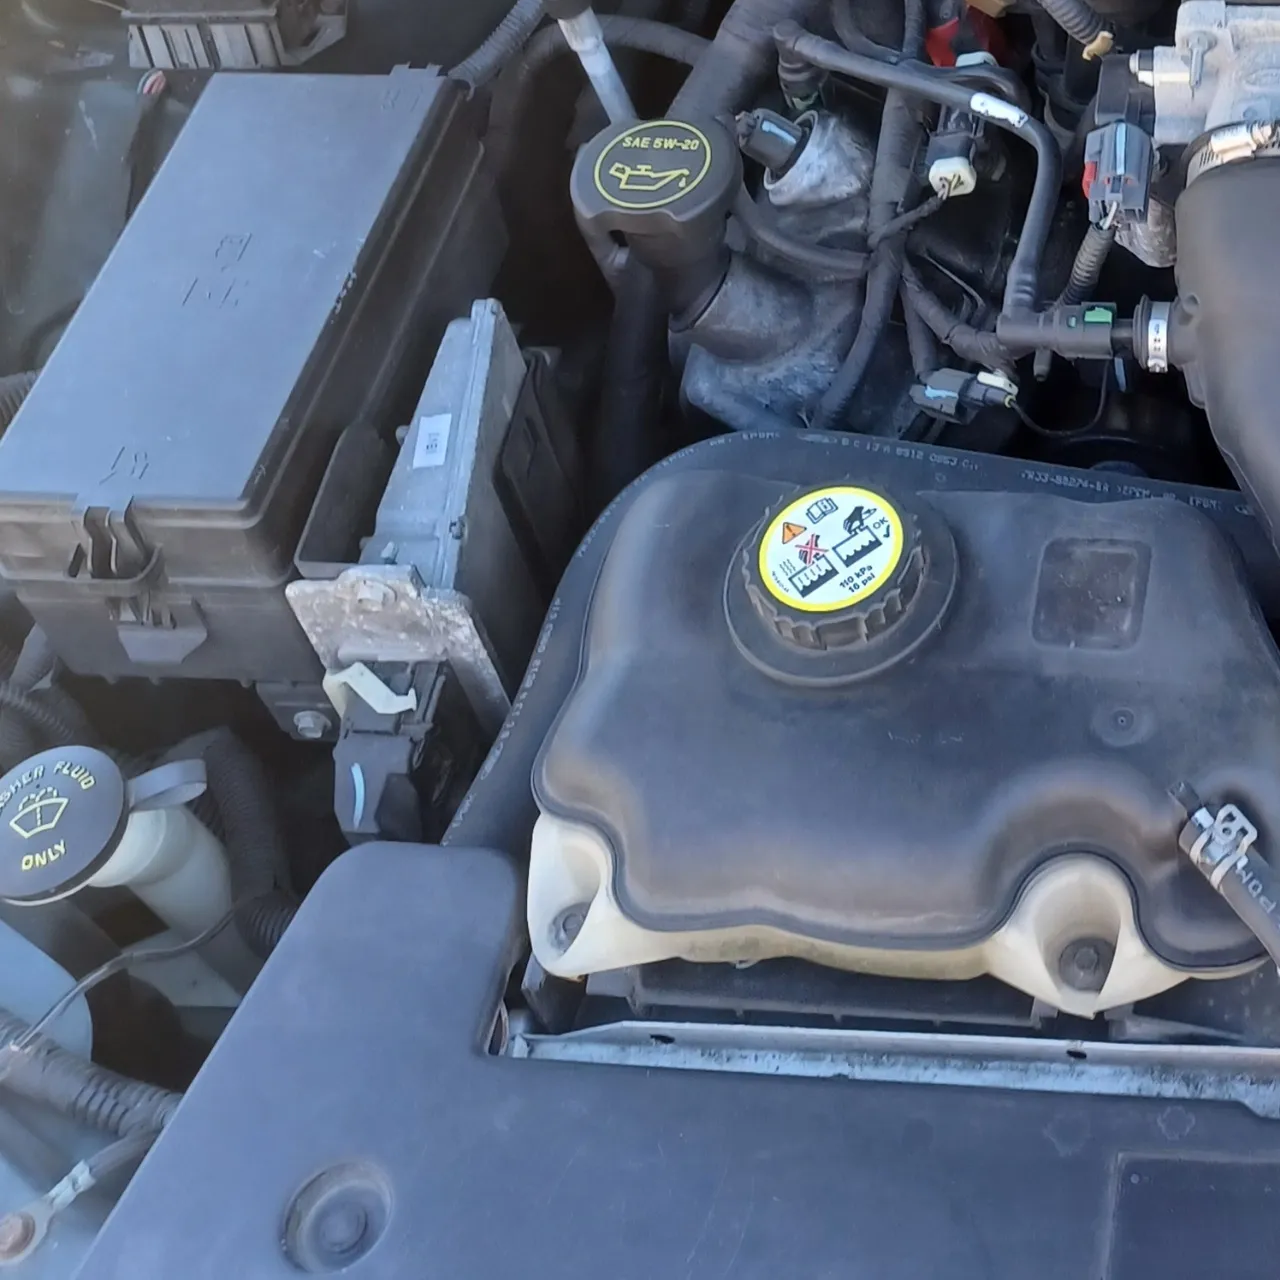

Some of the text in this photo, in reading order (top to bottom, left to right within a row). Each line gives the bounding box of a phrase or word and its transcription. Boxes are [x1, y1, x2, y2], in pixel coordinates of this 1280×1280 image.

[622, 136, 700, 151] SAE 5W-20
[872, 516, 889, 530] OK
[839, 564, 873, 589] 110 kPa
[848, 582, 861, 593] 16
[0, 761, 96, 810] SHER FLUID
[22, 839, 65, 872] ONLY
